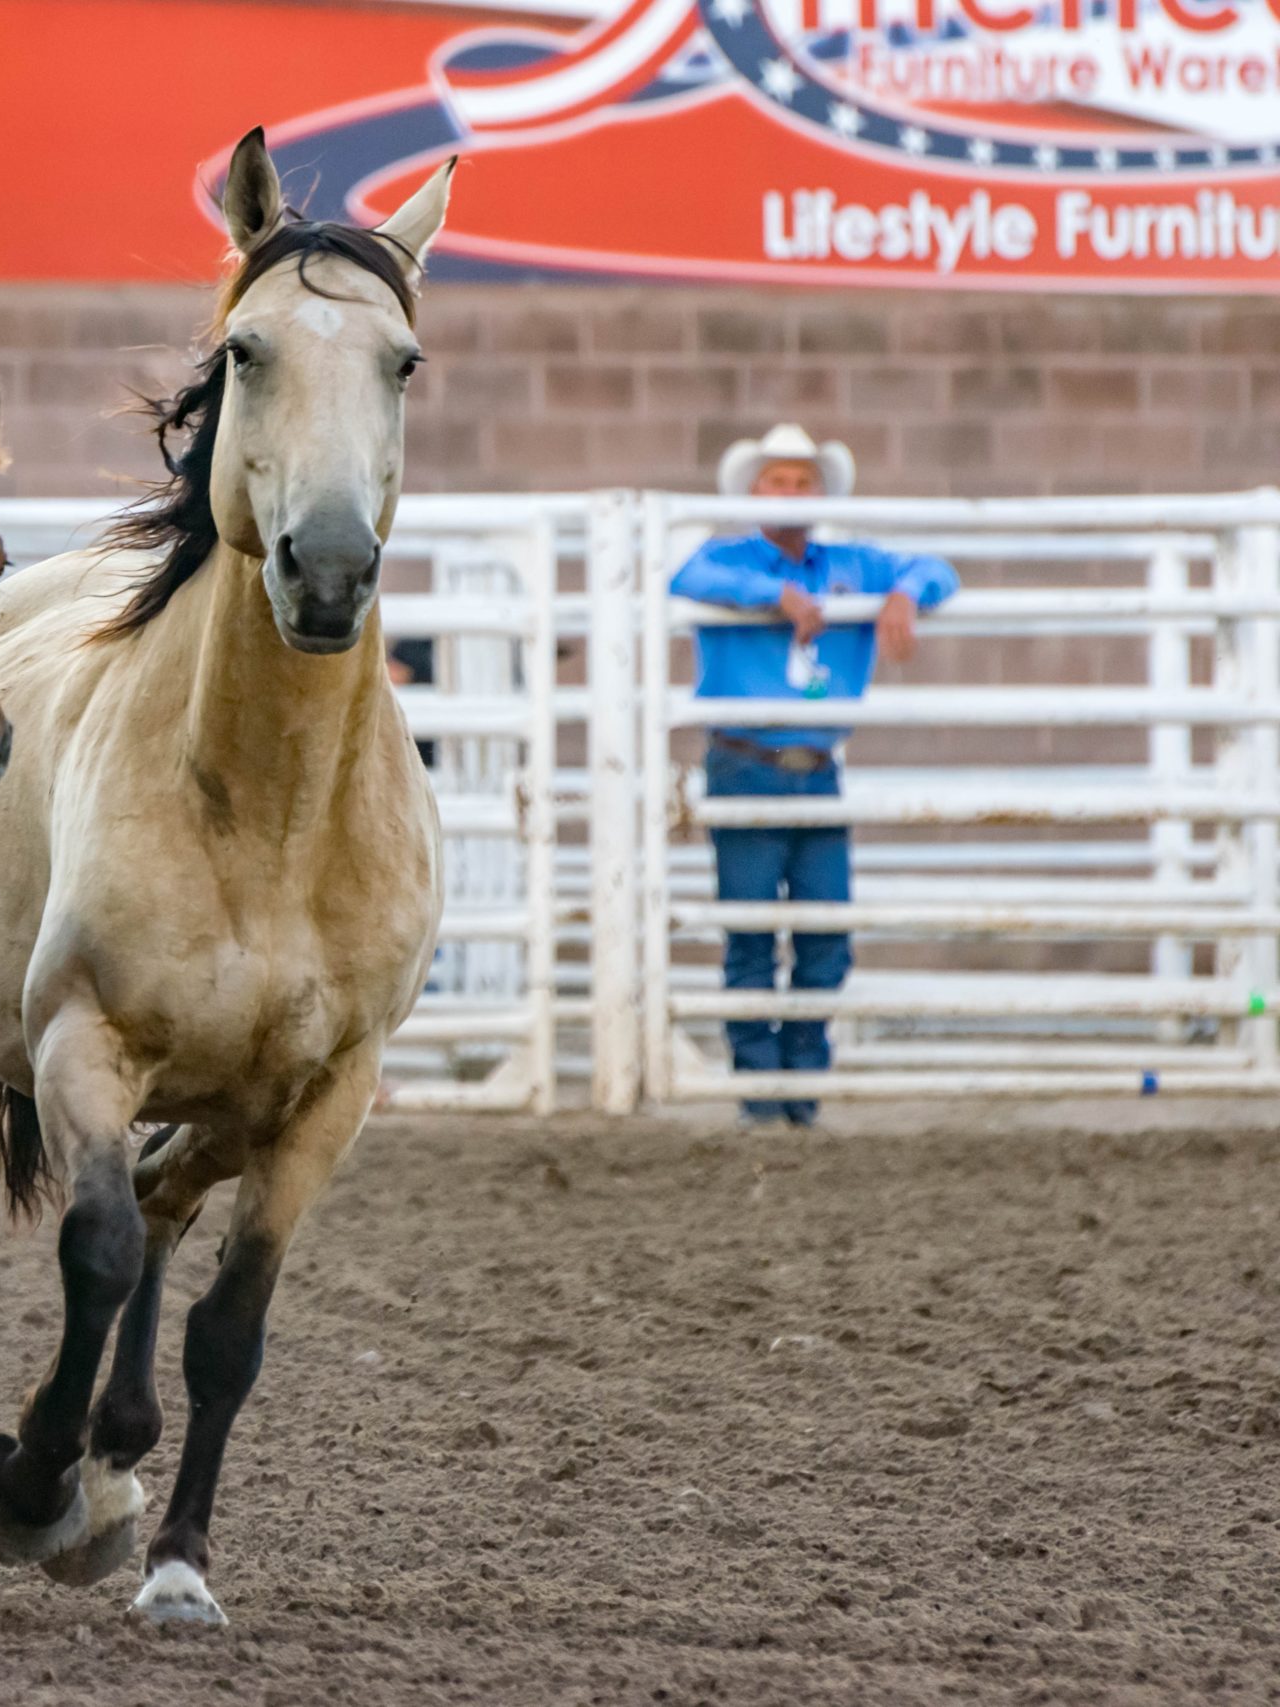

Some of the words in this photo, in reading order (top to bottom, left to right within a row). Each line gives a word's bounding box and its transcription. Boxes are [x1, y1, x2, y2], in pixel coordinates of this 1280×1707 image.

[860, 46, 1099, 97] Furniture
[1123, 44, 1280, 95] Ware
[763, 189, 1037, 274] Lifestyle
[1056, 189, 1280, 259] Furnitu
